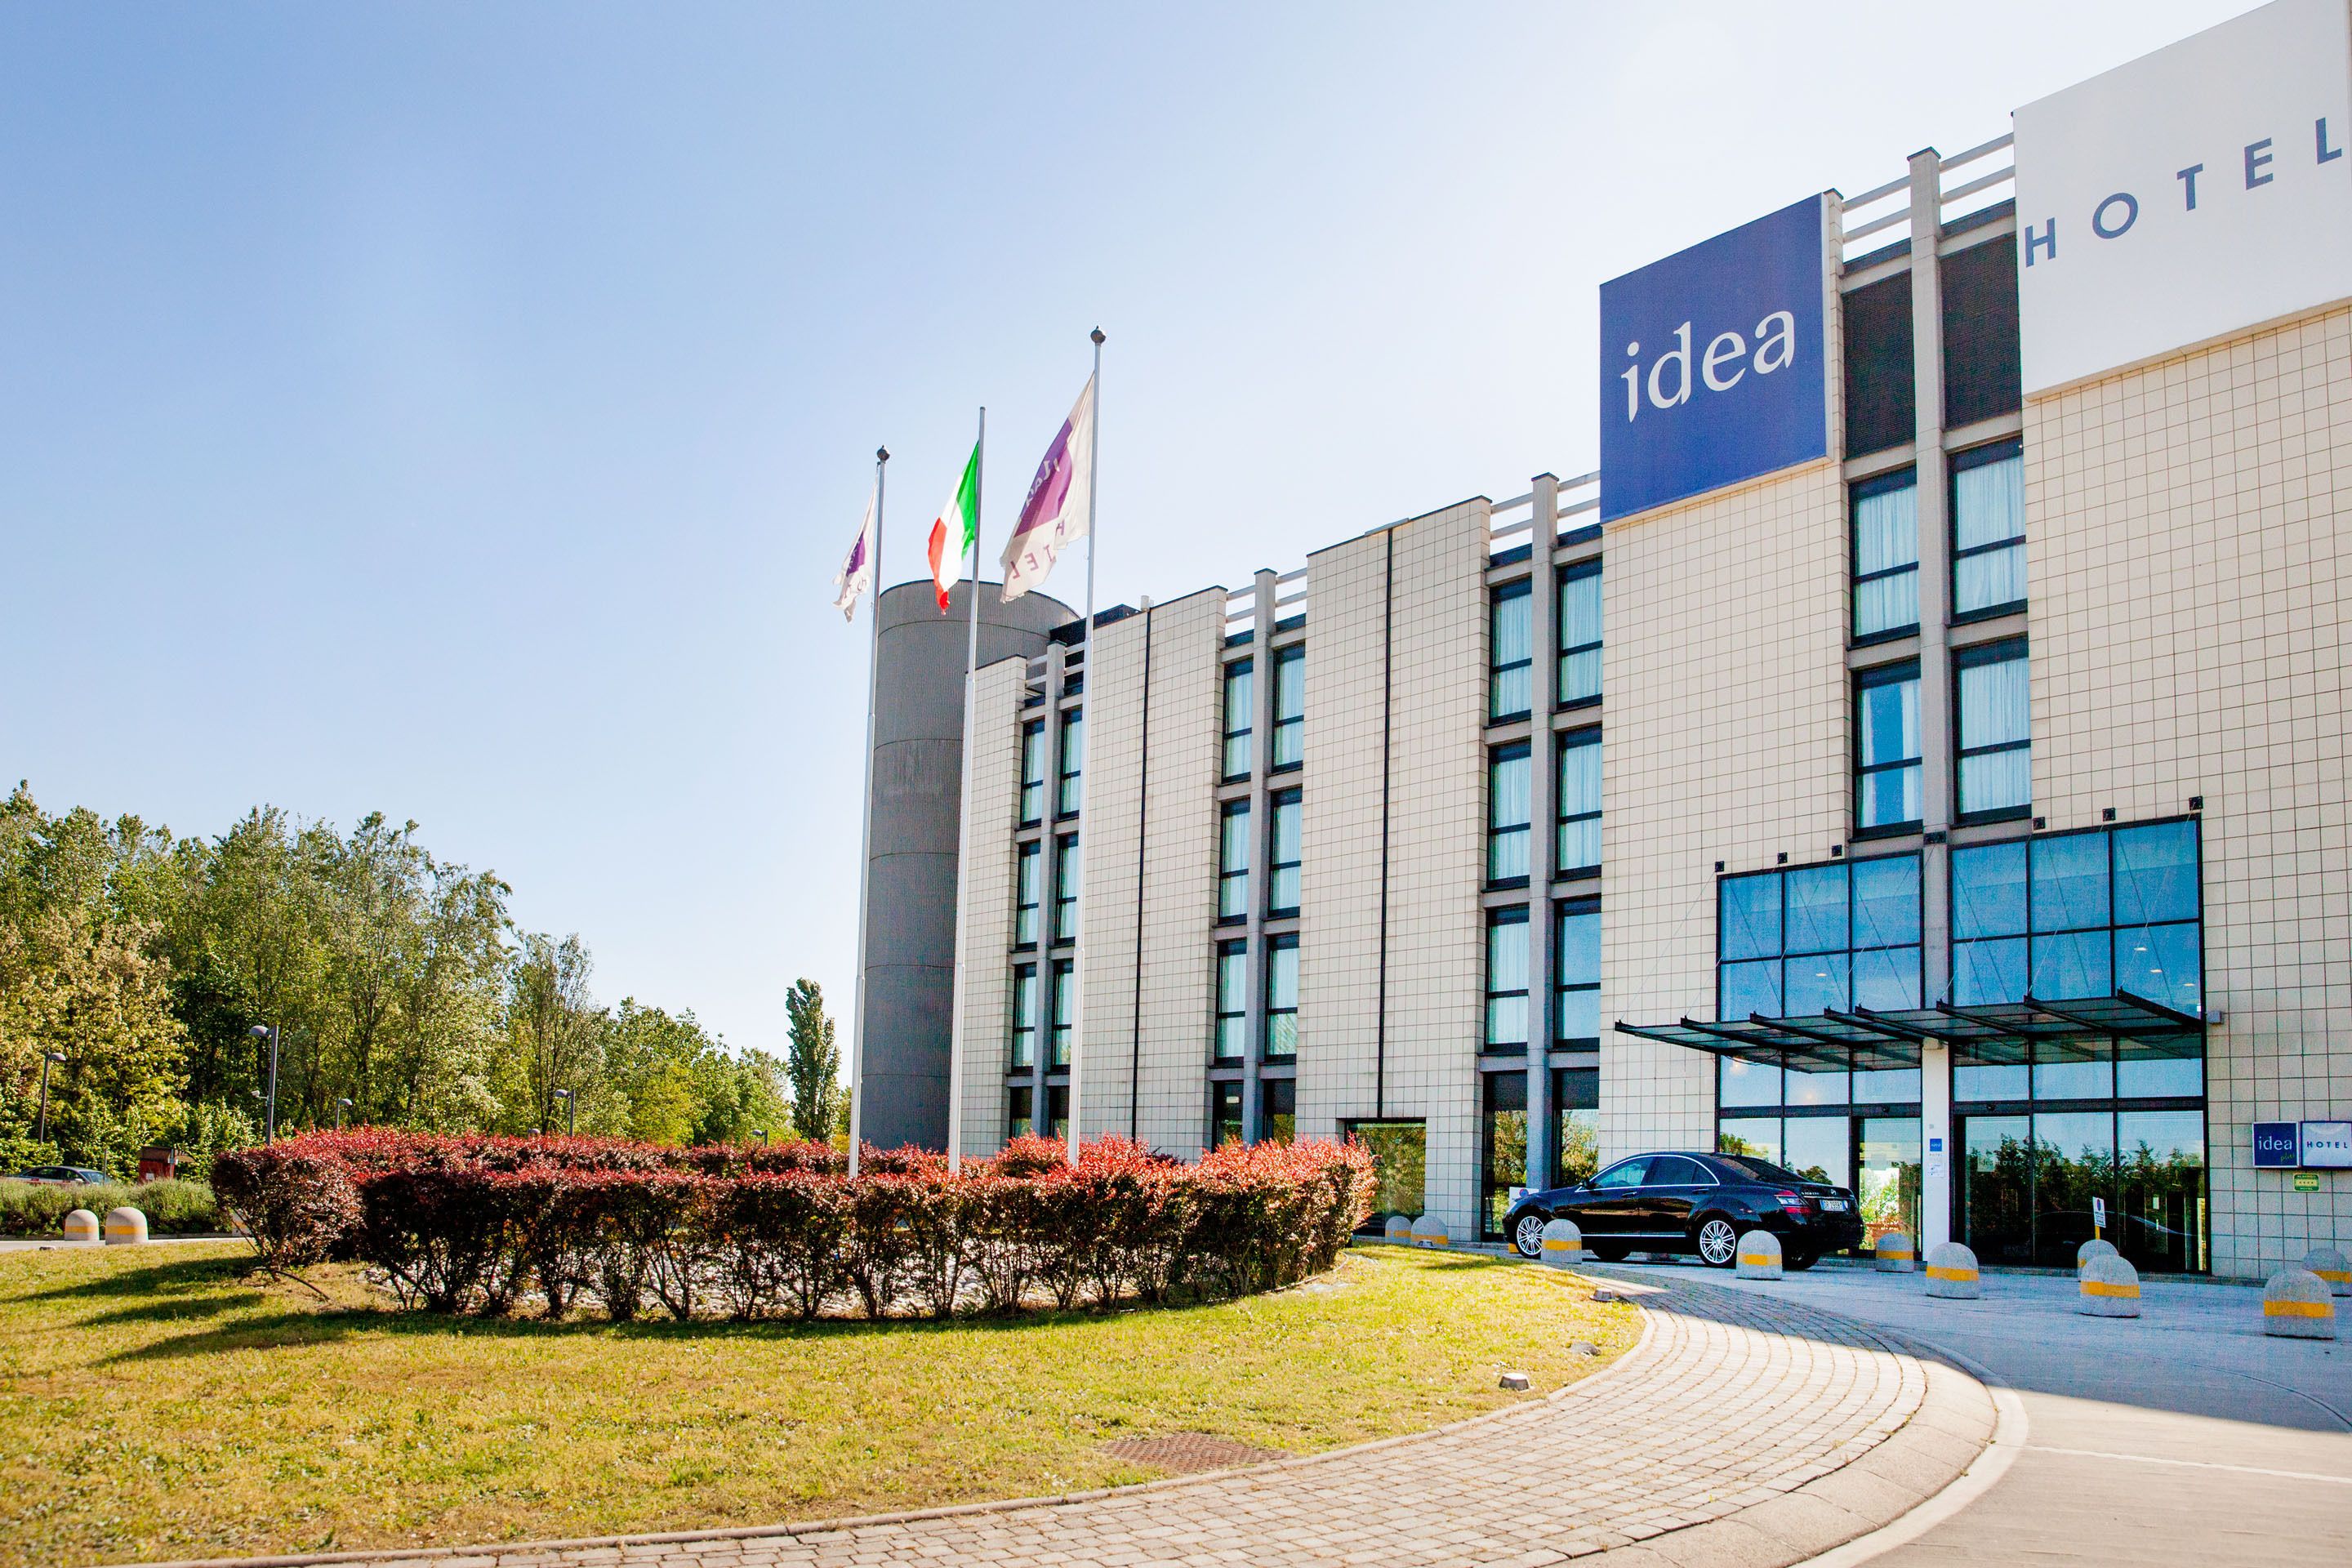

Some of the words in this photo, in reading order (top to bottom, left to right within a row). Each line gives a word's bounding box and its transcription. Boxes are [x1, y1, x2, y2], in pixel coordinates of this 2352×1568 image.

[2025, 116, 2344, 269] HOTEL
[1619, 310, 1796, 424] idea
[2258, 1136, 2292, 1151] idea
[2306, 1141, 2348, 1149] HOTEL
